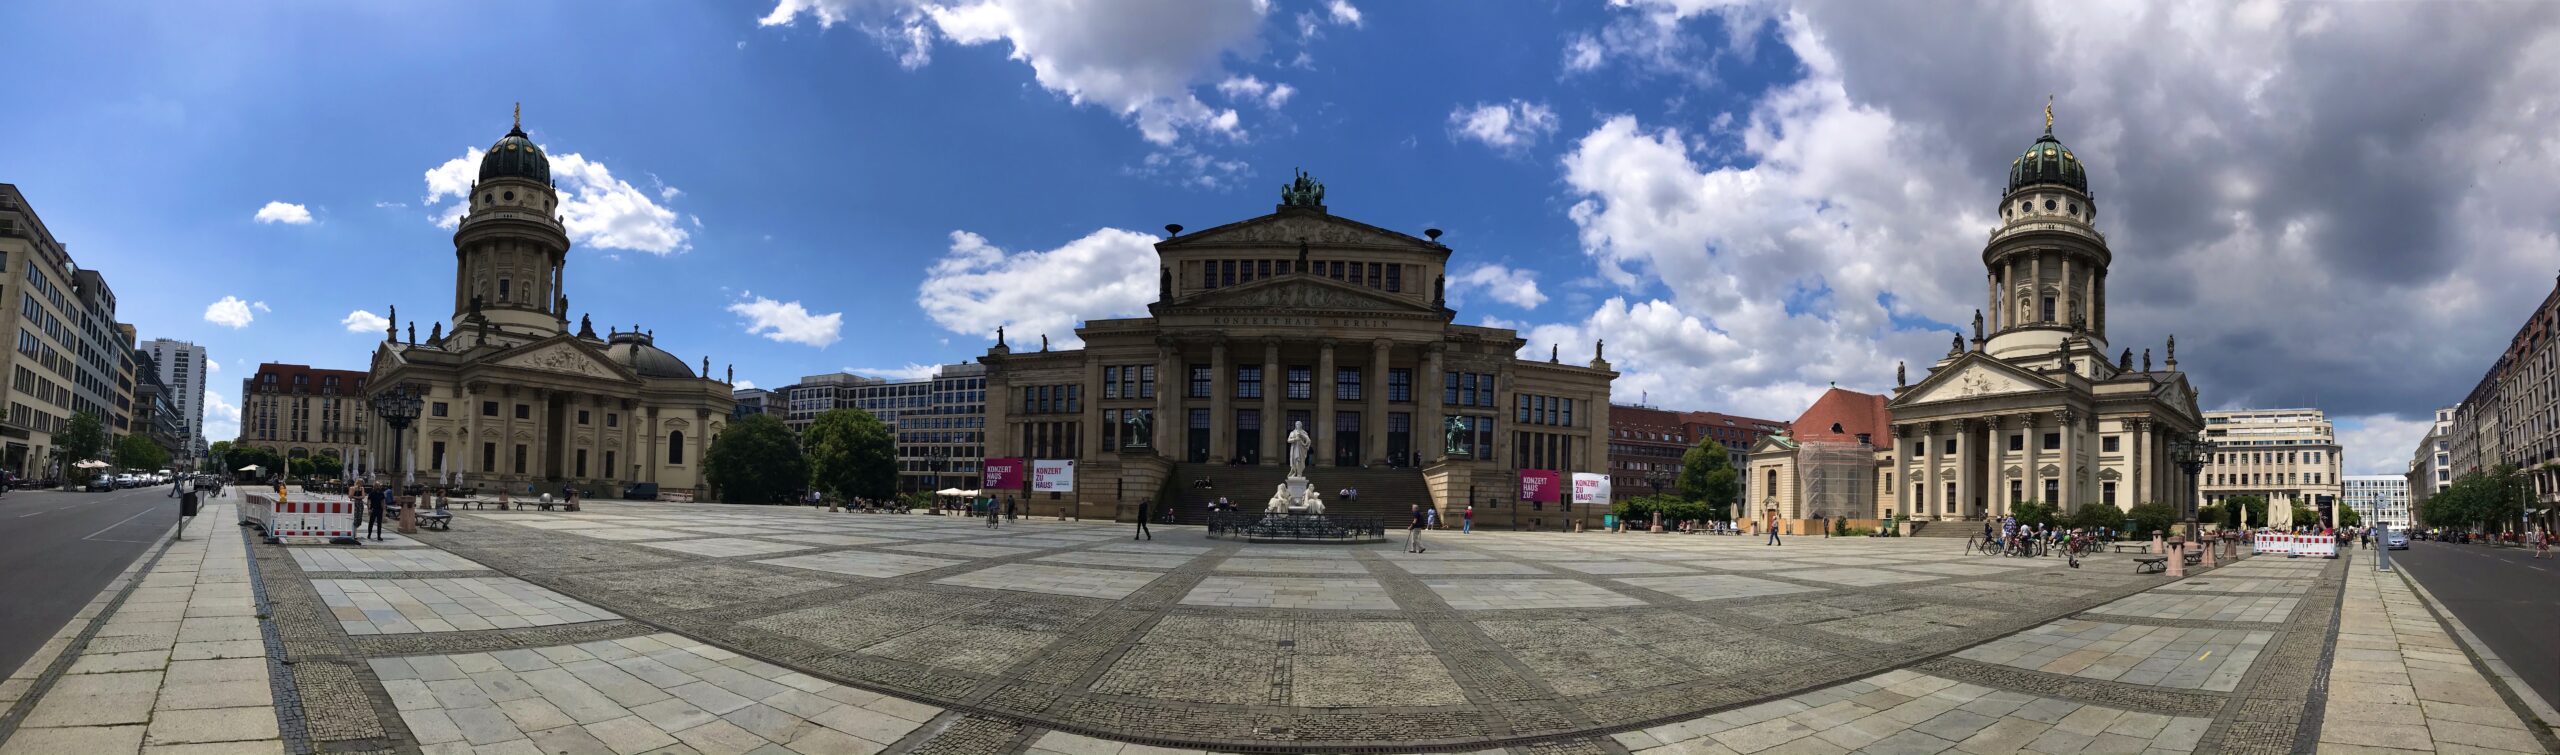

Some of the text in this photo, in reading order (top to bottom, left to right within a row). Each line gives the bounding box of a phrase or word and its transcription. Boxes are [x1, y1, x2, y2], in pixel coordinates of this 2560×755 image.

[1333, 319, 1389, 328] BERLIN
[1523, 477, 1547, 485] KONZERT
[1523, 484, 1539, 492] HAUS
[1523, 491, 1534, 499] ZU?
[1575, 493, 1593, 501] HAUS!
